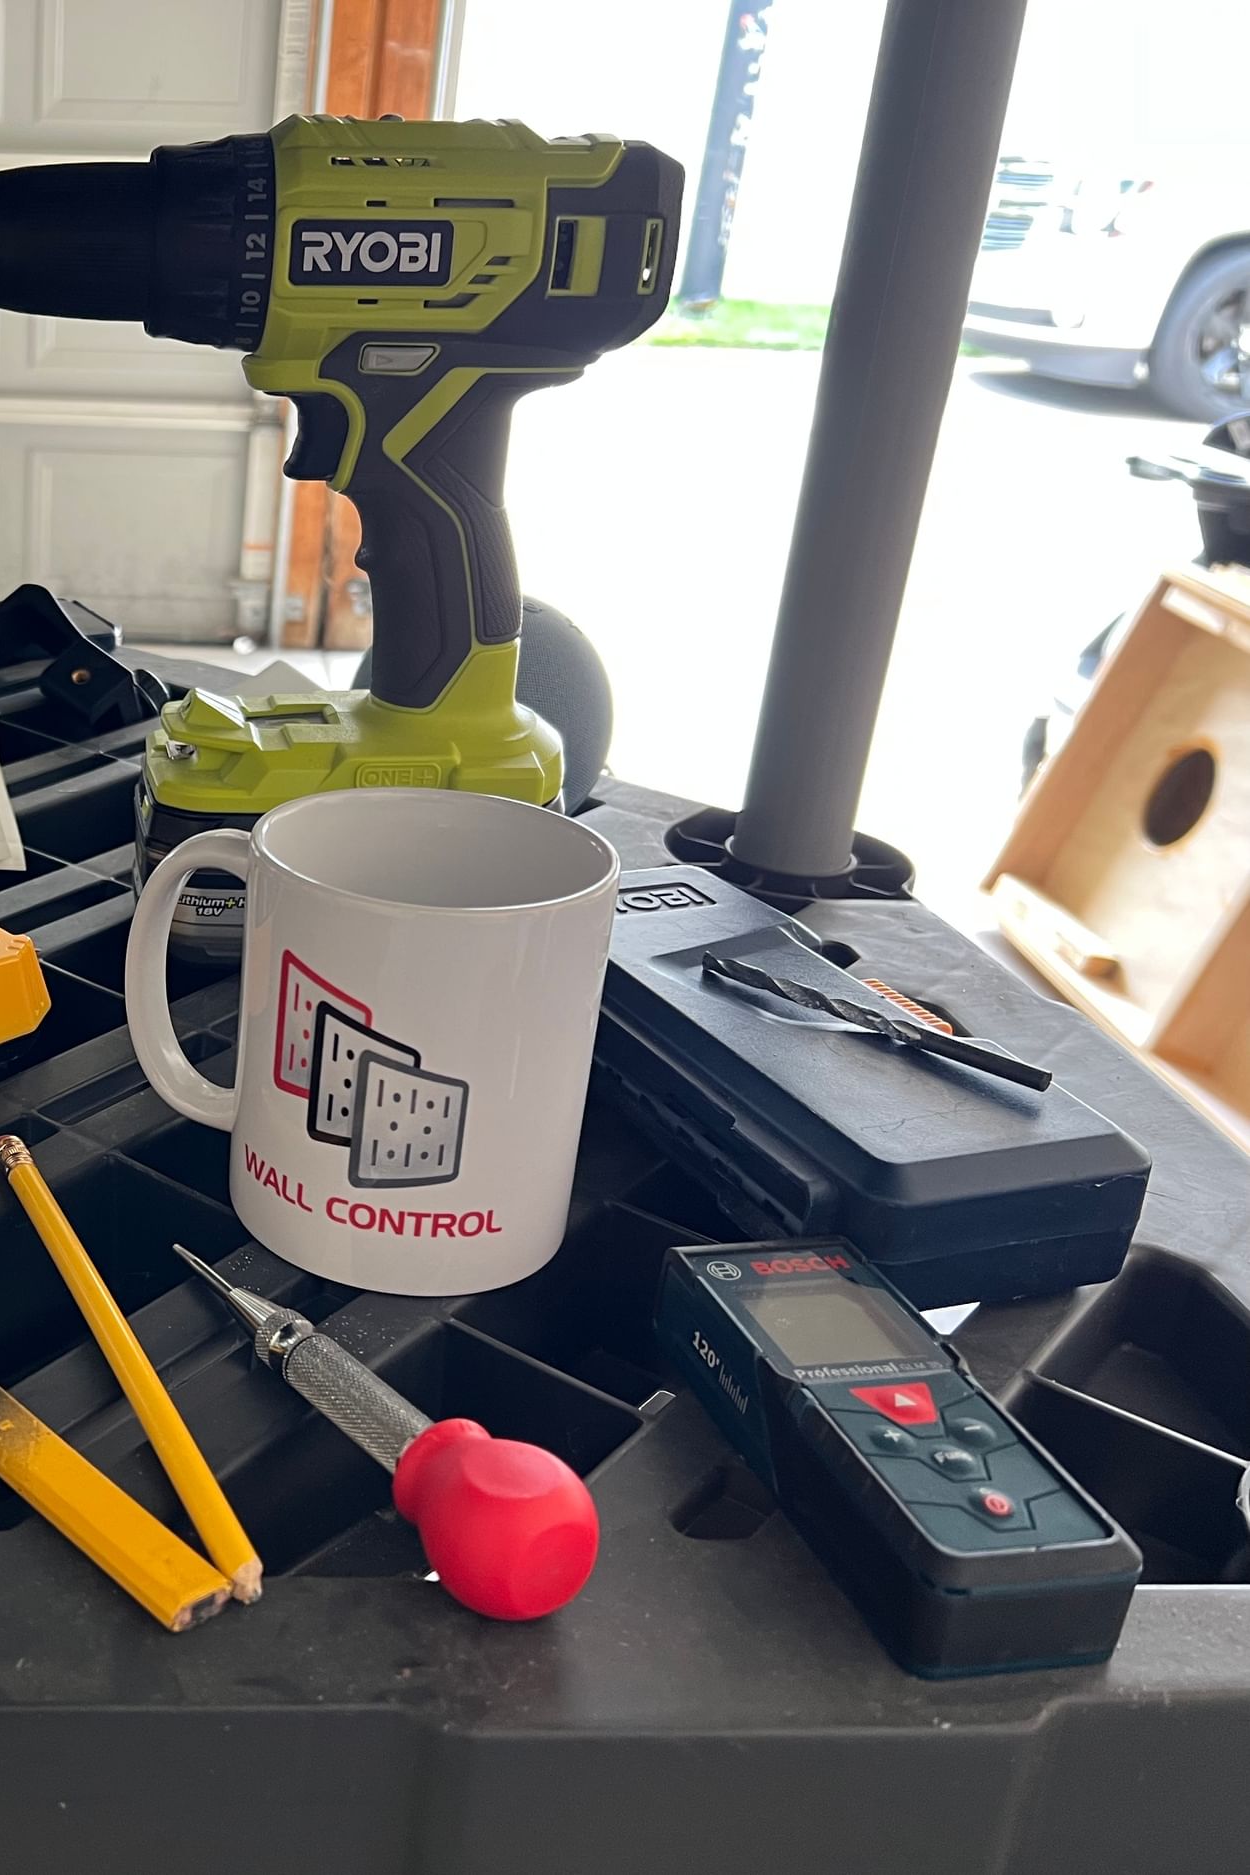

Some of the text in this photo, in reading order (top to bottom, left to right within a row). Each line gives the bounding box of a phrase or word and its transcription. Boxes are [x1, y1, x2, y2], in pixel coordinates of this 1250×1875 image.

[247, 177, 267, 202] 14
[245, 232, 266, 261] 12
[301, 231, 442, 273] RYOBI
[240, 290, 261, 314] 10
[196, 907, 223, 917] 18V
[244, 1143, 313, 1213] WALL
[325, 1196, 503, 1239] CONTROL
[750, 1254, 851, 1277] BOSCH
[793, 1361, 898, 1380] Professional
